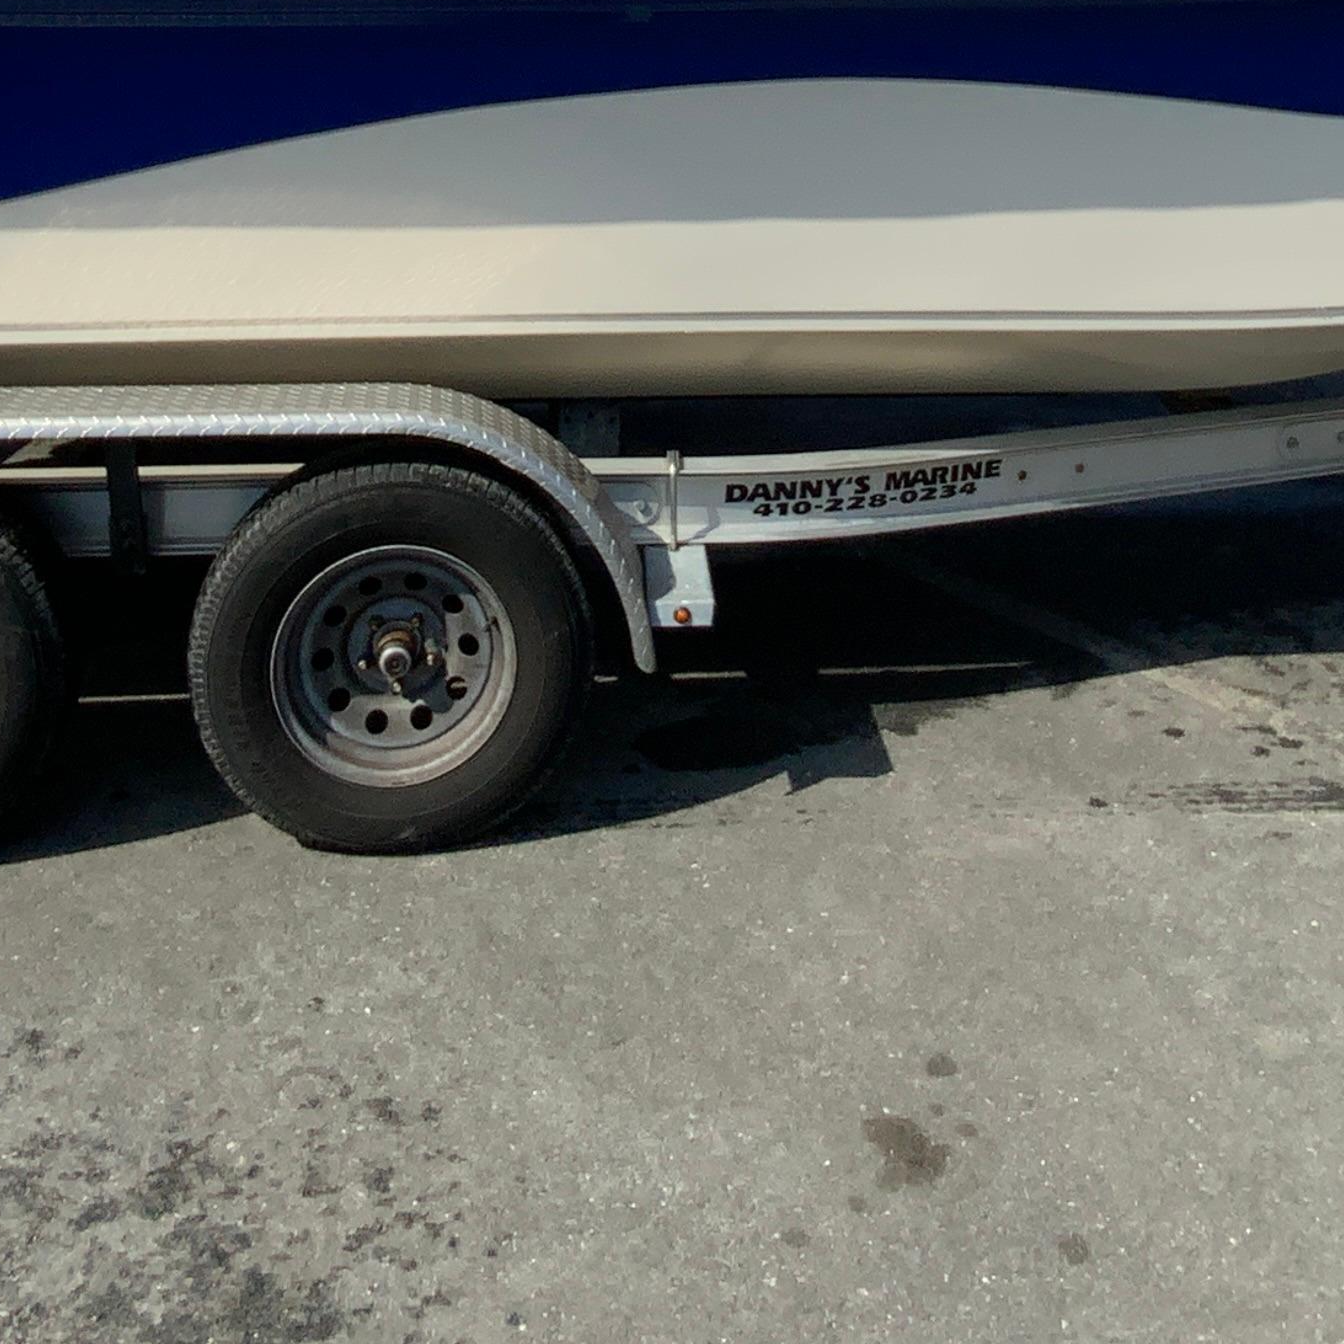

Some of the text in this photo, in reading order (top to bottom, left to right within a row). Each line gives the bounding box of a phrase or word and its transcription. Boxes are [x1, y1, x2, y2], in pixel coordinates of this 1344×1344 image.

[724, 458, 1004, 504] DANNY'S MARINE
[752, 481, 978, 518] 410-228-0234
